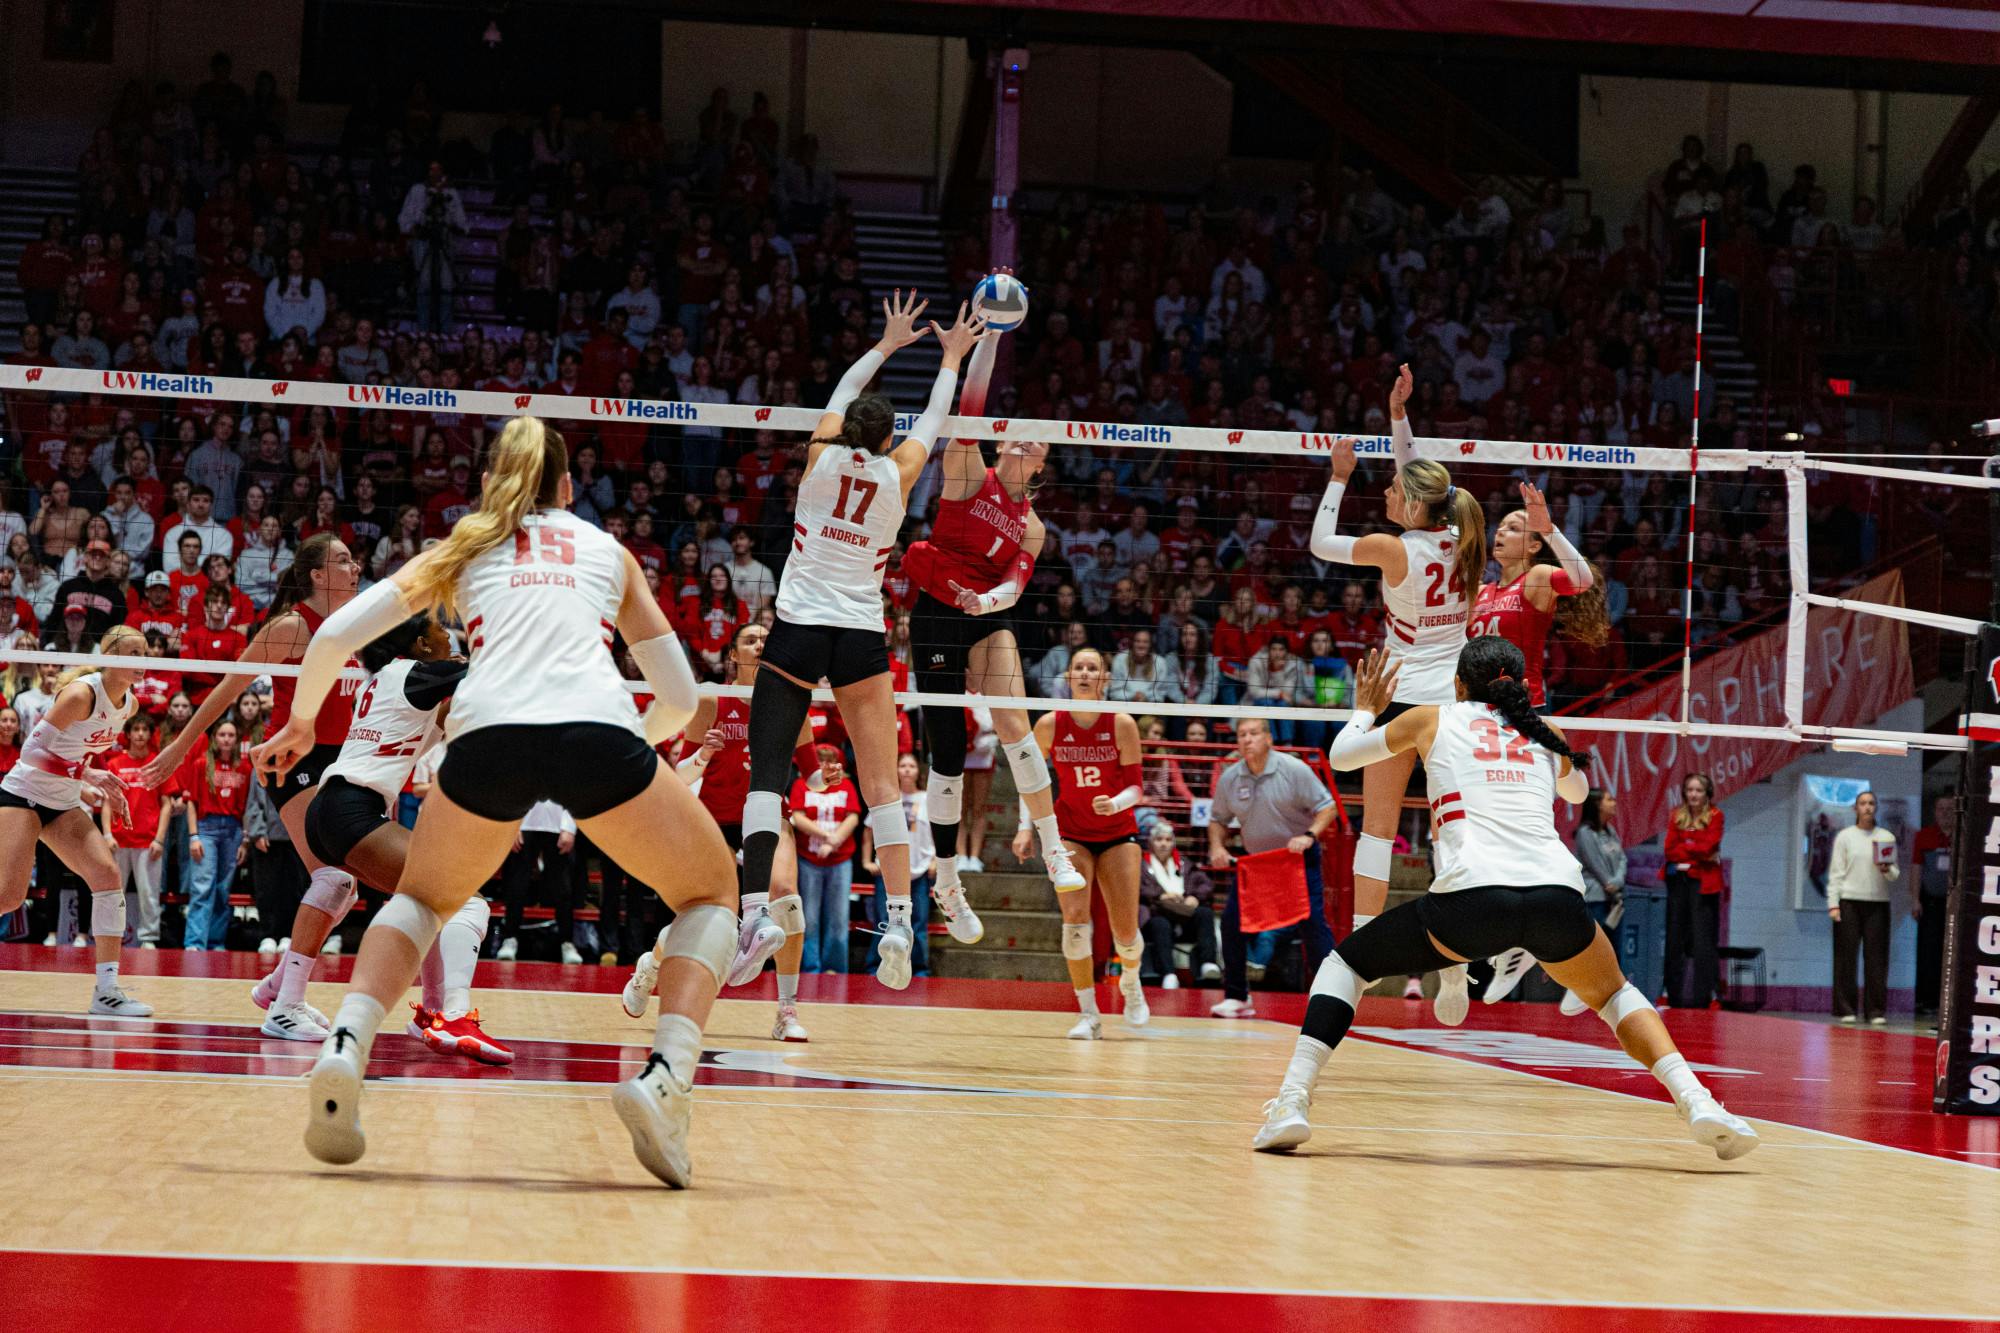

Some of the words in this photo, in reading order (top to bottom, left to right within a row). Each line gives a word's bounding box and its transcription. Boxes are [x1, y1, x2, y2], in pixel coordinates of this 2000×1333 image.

[832, 474, 879, 526] 17
[514, 526, 576, 566] 15
[820, 525, 870, 548] ANDREW
[986, 536, 1004, 558] 1
[510, 571, 576, 589] COLYER
[1425, 562, 1467, 607] 24
[358, 678, 377, 719] 6
[1469, 717, 1535, 765] 32
[1054, 745, 1118, 763] INDIANA
[1074, 766, 1102, 788] 12
[1486, 768, 1526, 783] EGAN
